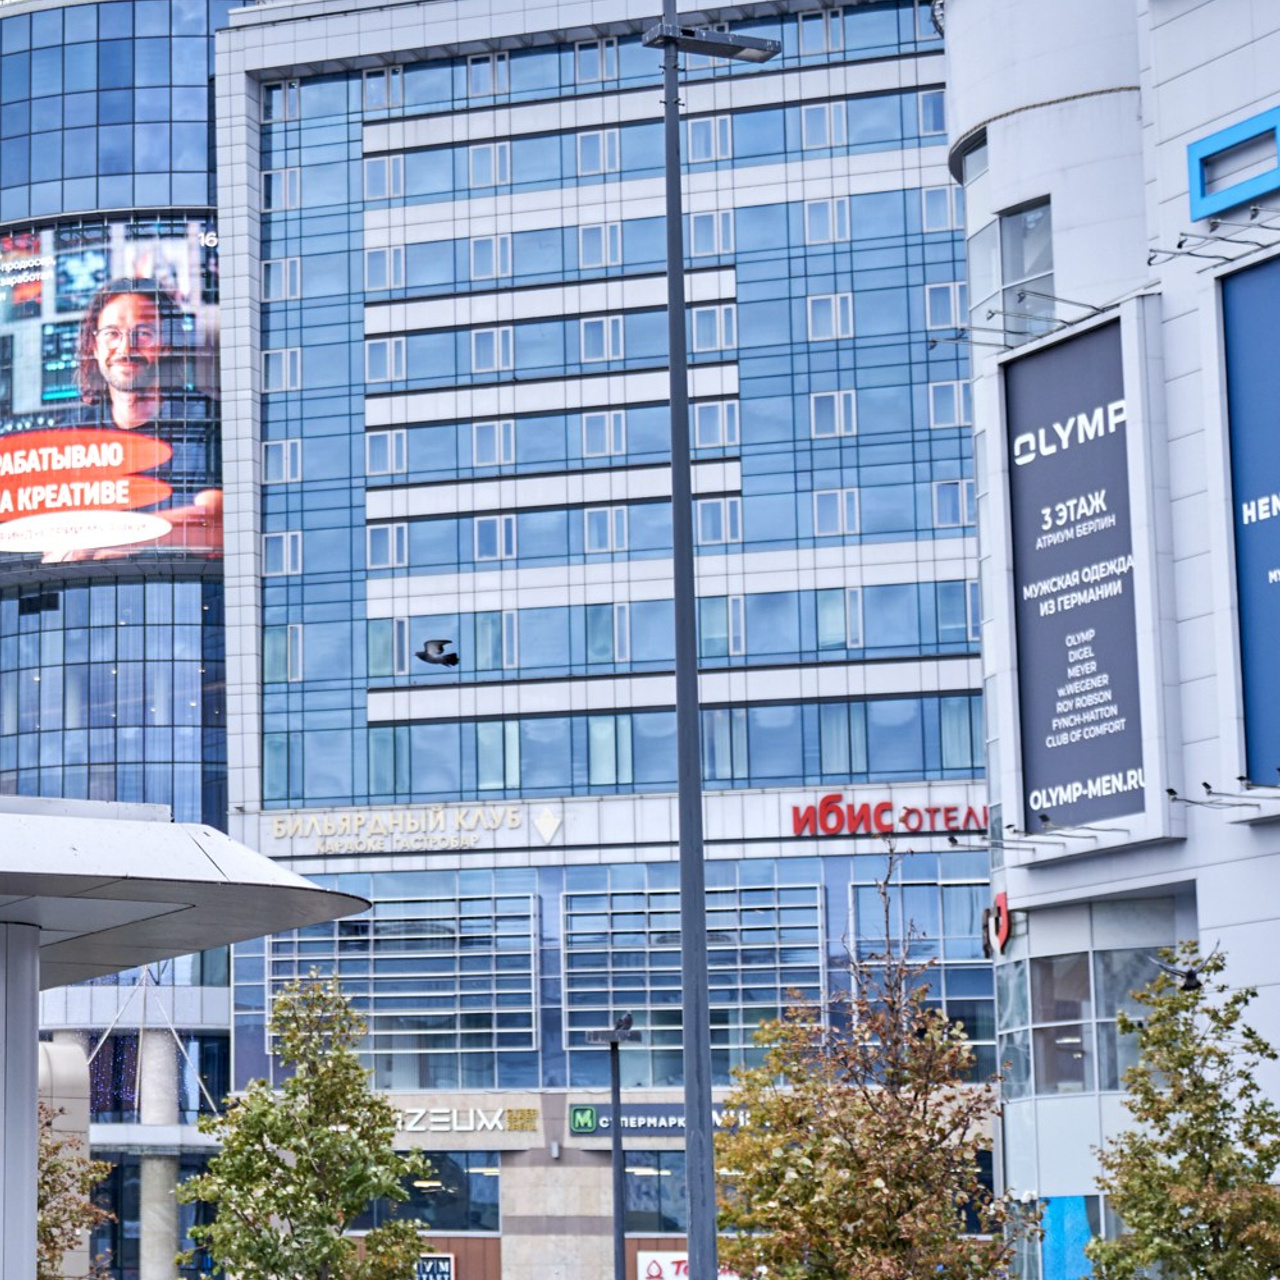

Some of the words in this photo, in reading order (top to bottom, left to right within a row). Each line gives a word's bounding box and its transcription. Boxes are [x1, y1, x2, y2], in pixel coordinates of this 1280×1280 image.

[1014, 399, 1128, 466] OLYMP
[18, 480, 130, 511] КРЕАТИВЕ
[1041, 508, 1053, 531] 3
[1055, 489, 1107, 527] ЭТАЖ
[1036, 528, 1075, 550] АТРИУМ
[1076, 514, 1116, 539] БЕРЛИН
[1023, 572, 1081, 600] МУЖСКАЯ
[1081, 554, 1136, 584] ОДЕЖДА
[1039, 601, 1056, 617] ИЗ
[1058, 580, 1123, 611] ГЕРМАНИИ
[1065, 629, 1096, 647] OLYMP
[1067, 661, 1097, 679] MEYER
[1068, 647, 1095, 663] DIGEL
[1056, 700, 1074, 714] ROY
[1075, 690, 1112, 709] ROBSON
[1052, 705, 1118, 731] FYNCH-HATTON
[1046, 730, 1070, 749] CLUB
[1071, 728, 1083, 743] OF
[1083, 719, 1126, 741] COMFORT
[273, 806, 447, 839] БИЛЬЯРДНЫЙ
[455, 804, 522, 832] КЛУБ
[792, 794, 894, 837] ибис
[317, 836, 386, 855] КАРАОКЕ
[392, 834, 480, 852] ГАСТРОБАР
